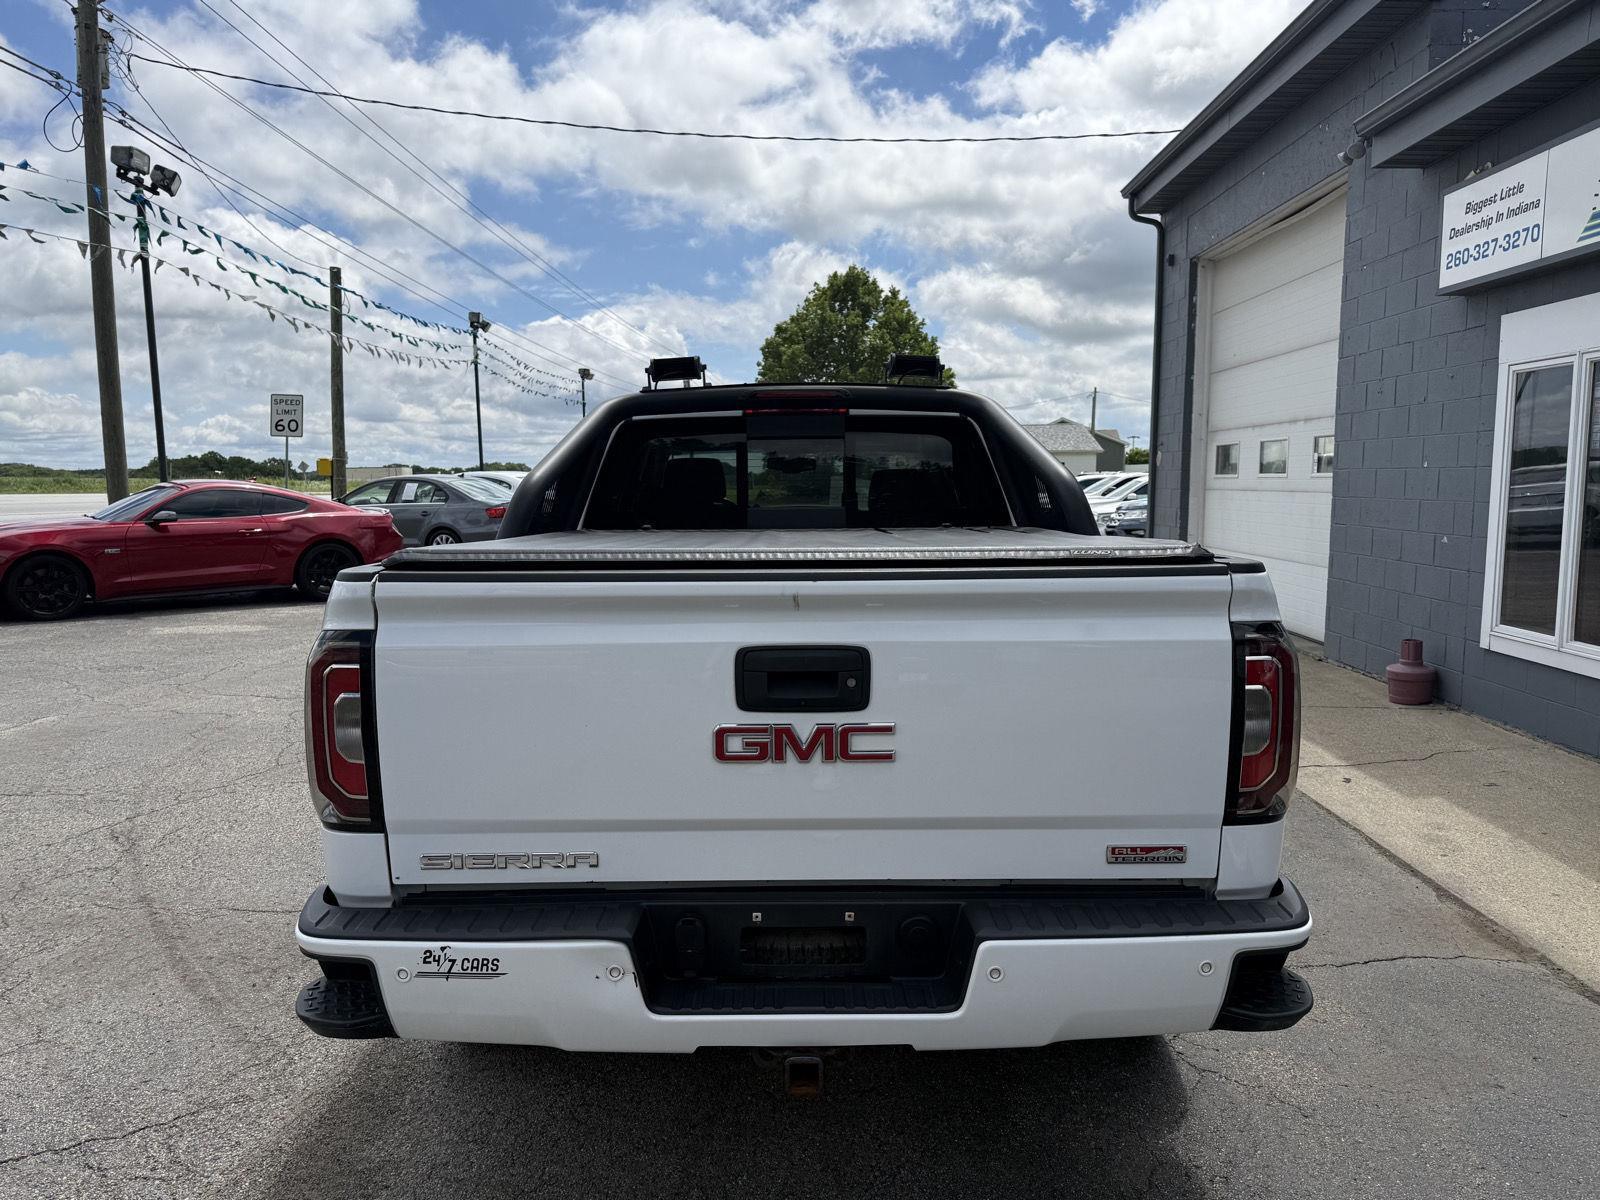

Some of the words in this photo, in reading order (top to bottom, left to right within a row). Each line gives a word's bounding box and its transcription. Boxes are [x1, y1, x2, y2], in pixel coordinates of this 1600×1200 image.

[1464, 192, 1498, 216] Biggest
[1499, 181, 1525, 202] Little
[1449, 214, 1494, 241] Dealership
[1495, 211, 1504, 223] In
[1506, 198, 1541, 220] Indiana
[1445, 223, 1541, 270] 260-327-3270
[273, 398, 301, 406] SPEED
[274, 418, 299, 433] 60
[713, 722, 897, 764] GMC
[420, 851, 600, 870] SIERRA
[1111, 855, 1185, 863] TERRAIN
[1114, 847, 1147, 855] ALL
[422, 948, 457, 974] 24/7
[460, 957, 500, 973] CARS
